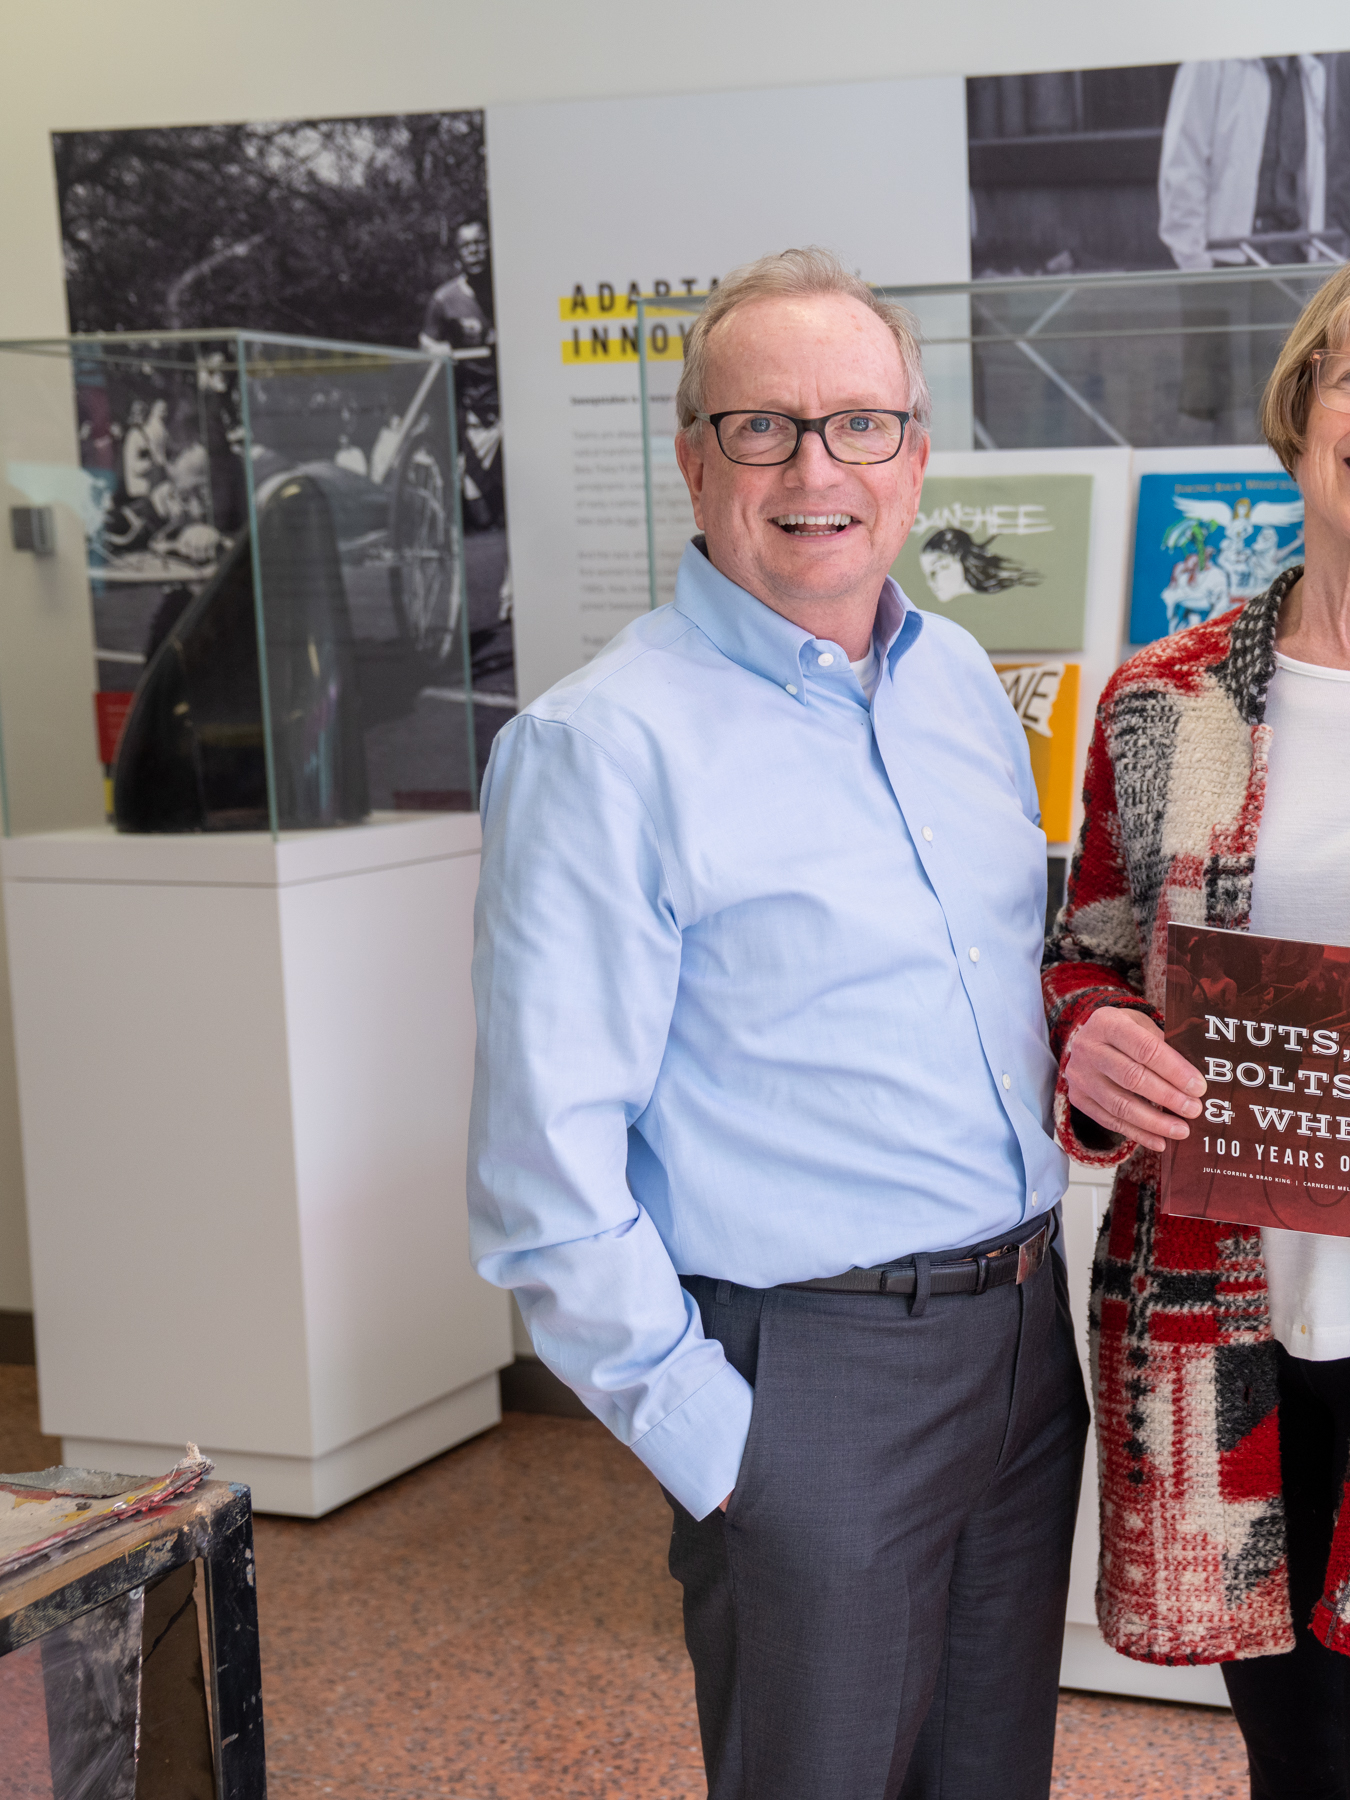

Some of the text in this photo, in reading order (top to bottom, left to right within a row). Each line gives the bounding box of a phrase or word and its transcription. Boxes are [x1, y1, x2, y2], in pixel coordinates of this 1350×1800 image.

[1204, 1098, 1236, 1125] &
[1203, 1136, 1241, 1158] 100
[1255, 1143, 1325, 1170] YEARS
[1222, 1169, 1247, 1178] CORRIN
[1256, 1174, 1273, 1182] BRAD
[1274, 1177, 1291, 1185] KING
[1303, 1181, 1335, 1190] CARNEGIE
